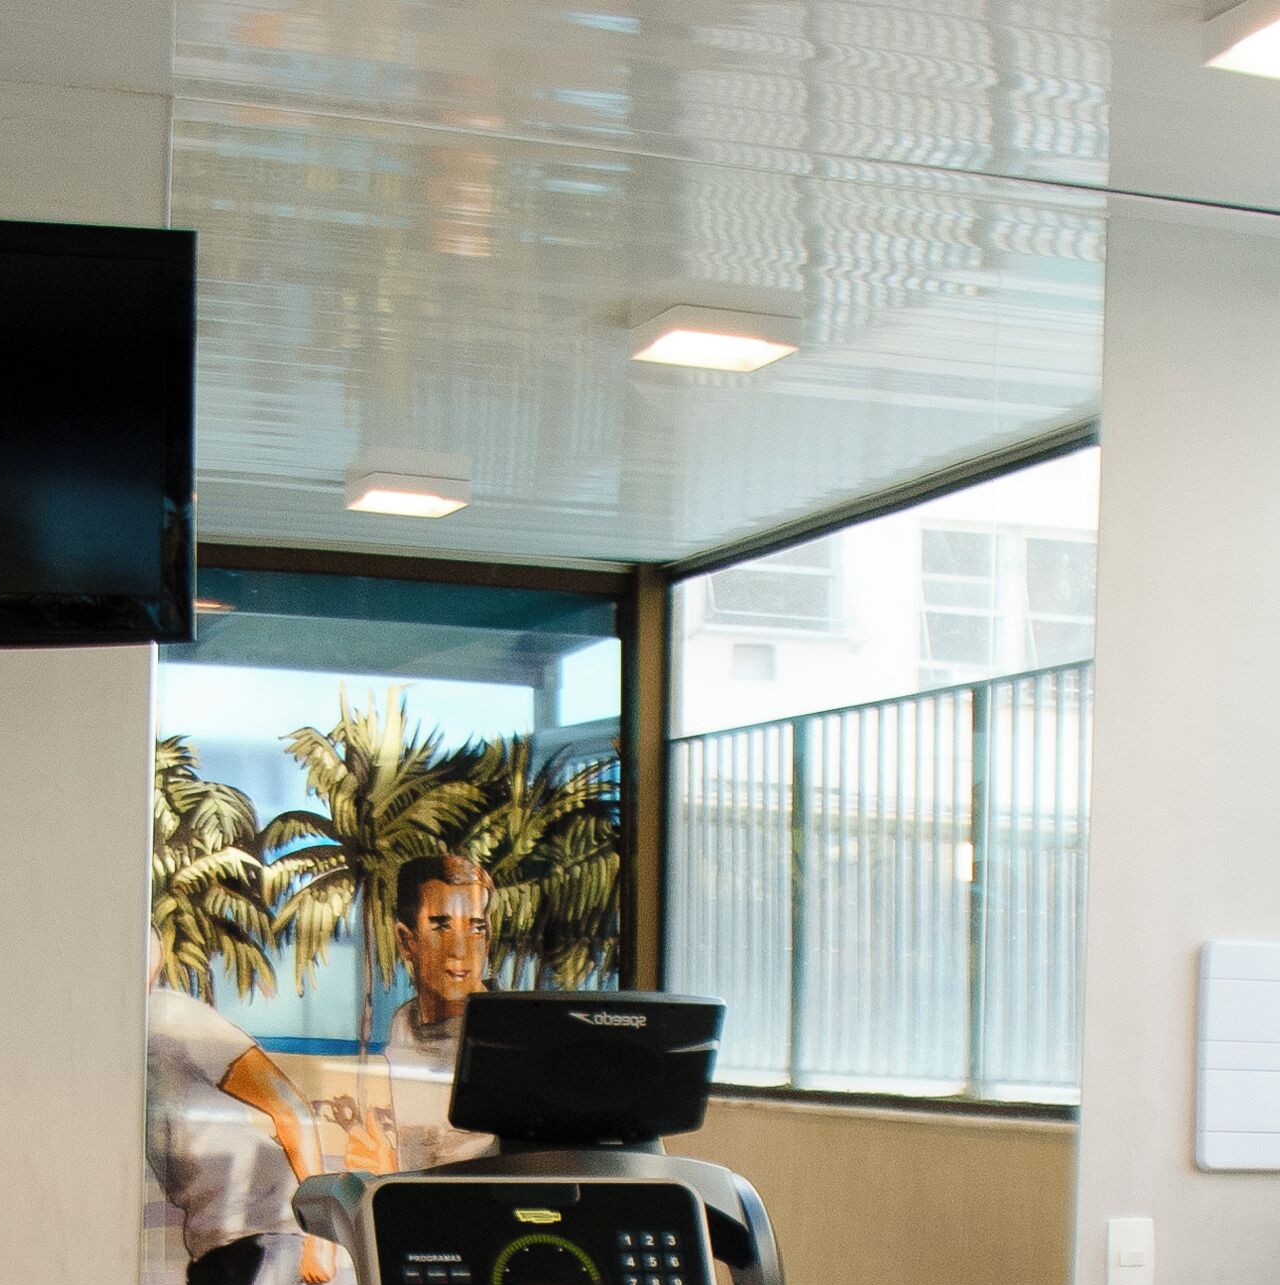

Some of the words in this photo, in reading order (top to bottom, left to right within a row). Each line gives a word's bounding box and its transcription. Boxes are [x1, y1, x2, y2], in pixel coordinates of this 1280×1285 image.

[624, 1235, 632, 1246] 1
[645, 1235, 655, 1246] 2
[667, 1235, 676, 1246] 3
[625, 1256, 636, 1267] 4
[649, 1256, 658, 1268] 5
[670, 1256, 680, 1268] 6
